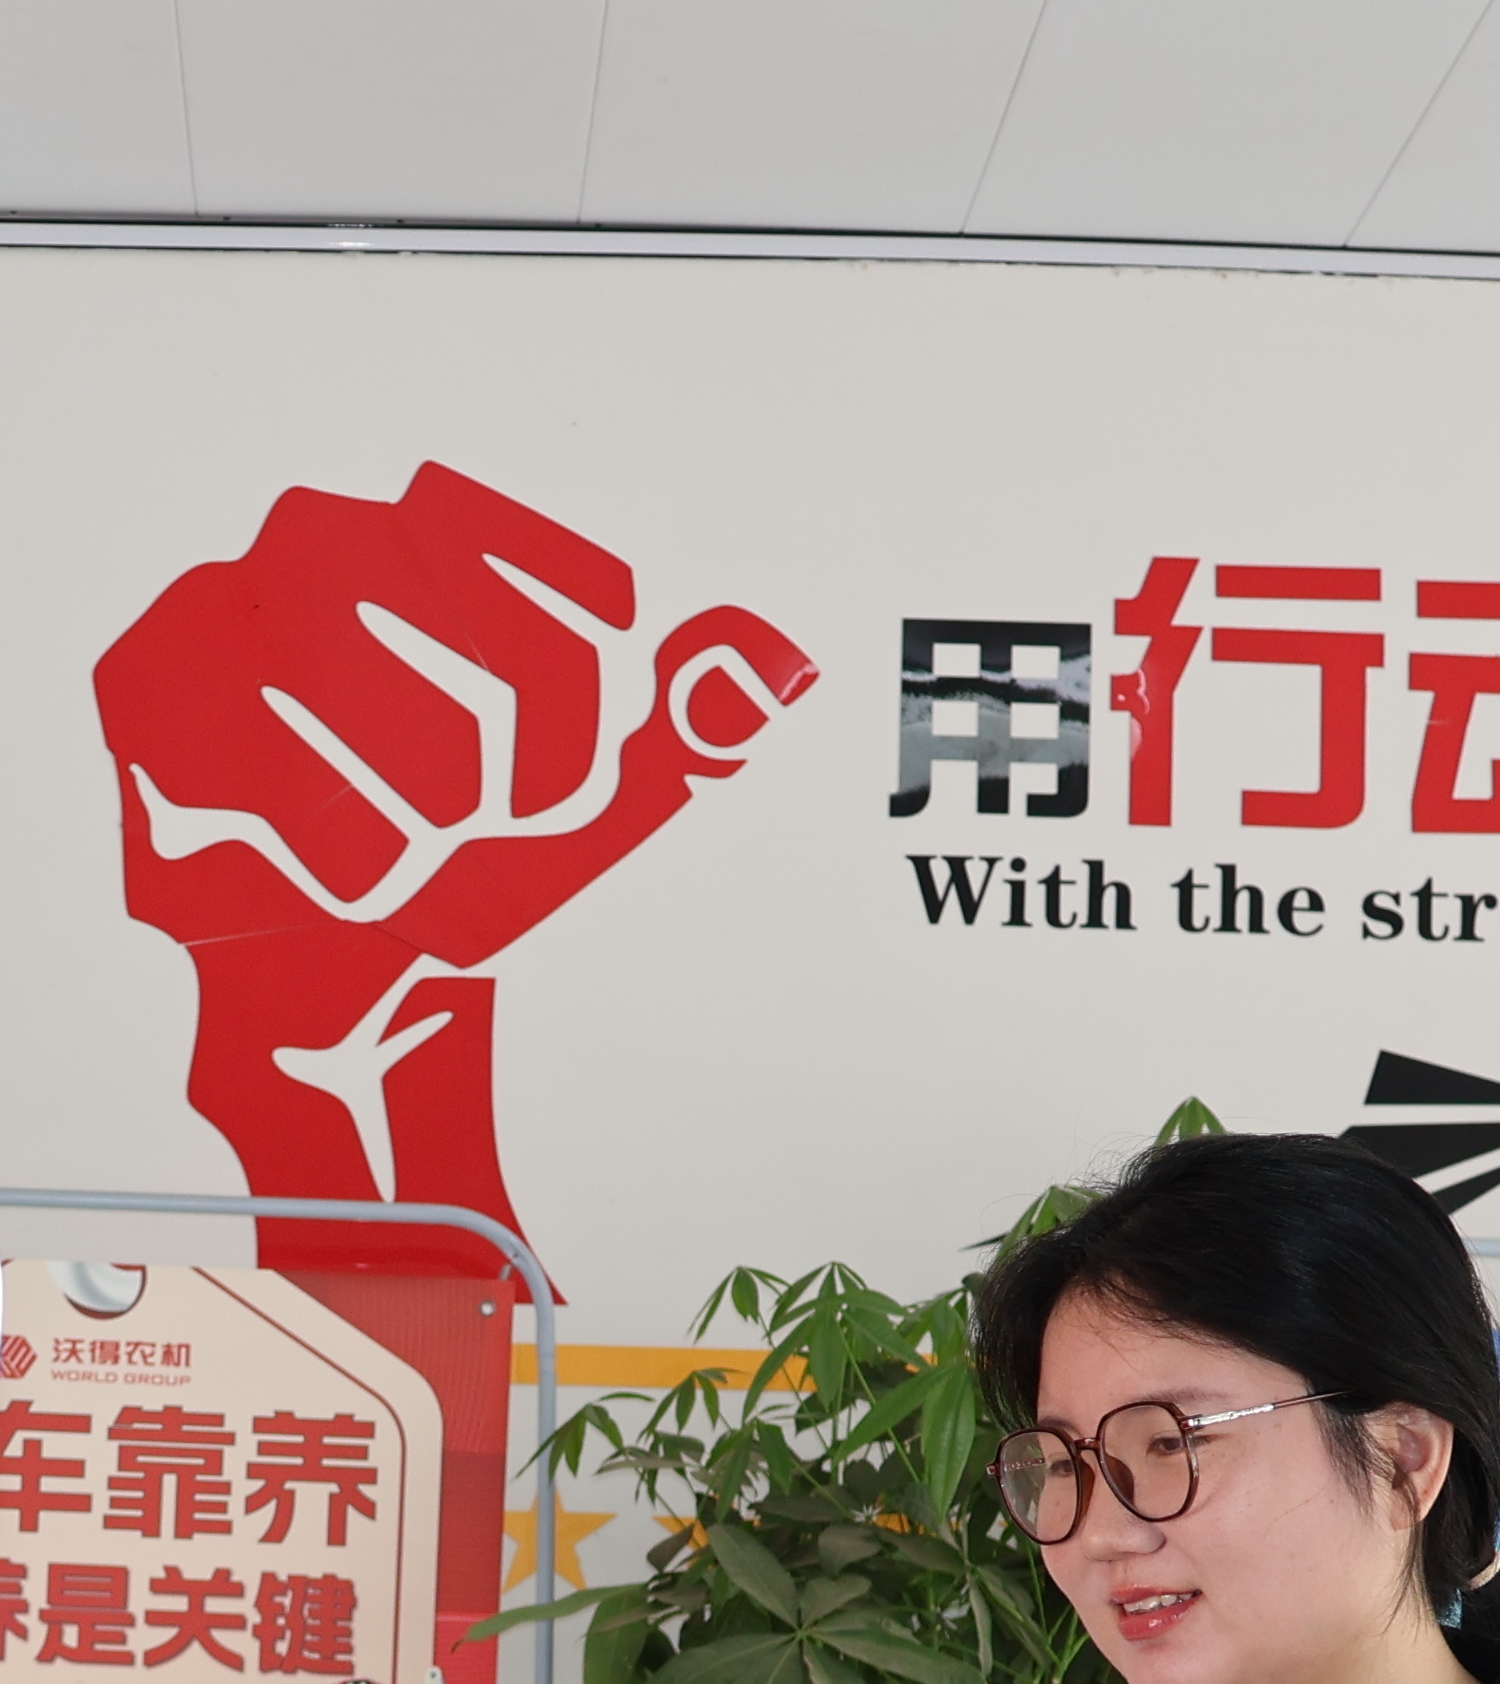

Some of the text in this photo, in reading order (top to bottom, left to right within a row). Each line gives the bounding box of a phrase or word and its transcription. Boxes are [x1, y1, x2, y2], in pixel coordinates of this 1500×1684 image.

[906, 854, 1137, 932] With
[1170, 863, 1326, 938] the
[52, 1337, 192, 1368] 沃得农机
[52, 1369, 192, 1387] WORLD GROUP
